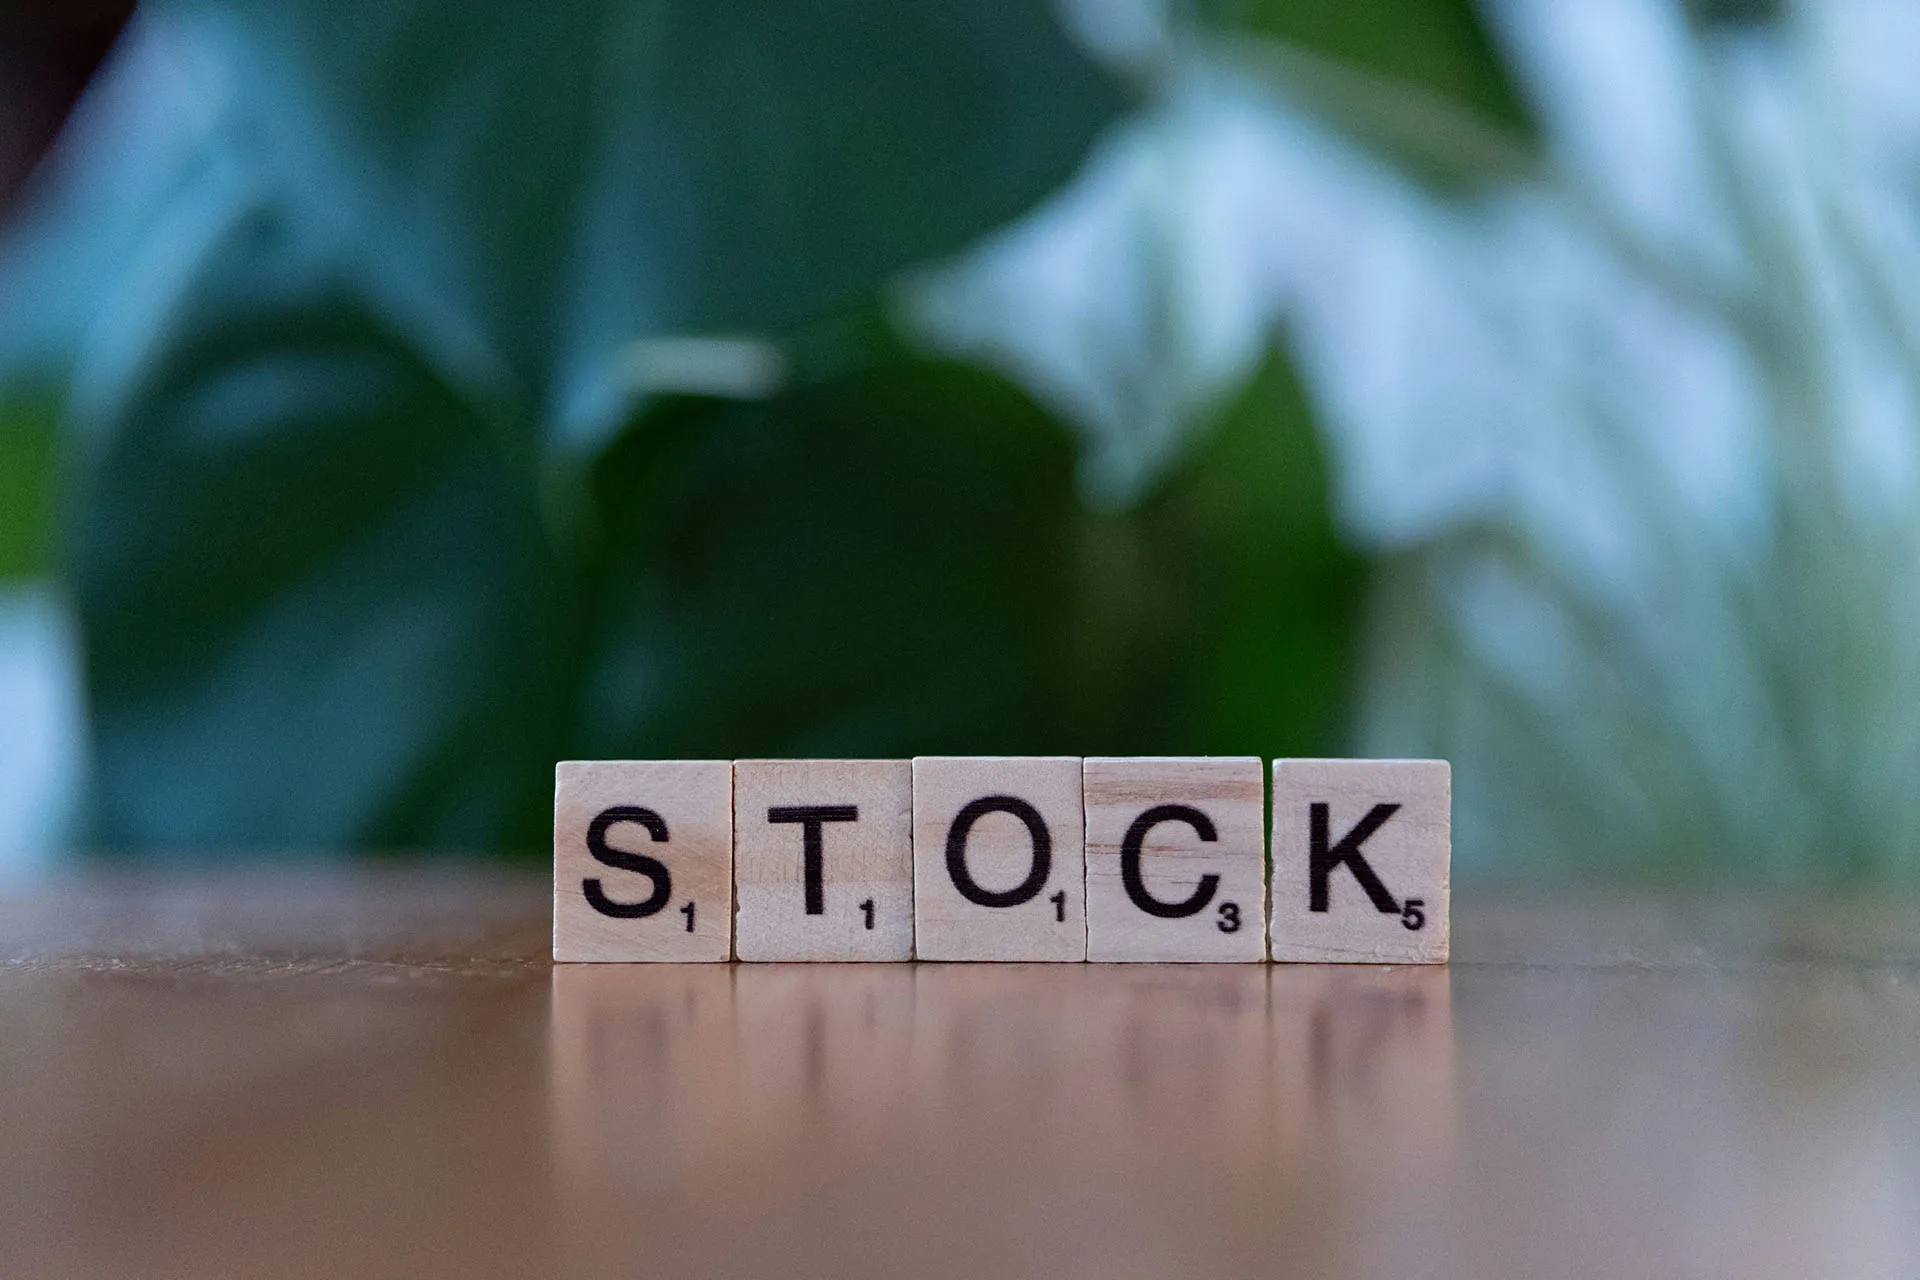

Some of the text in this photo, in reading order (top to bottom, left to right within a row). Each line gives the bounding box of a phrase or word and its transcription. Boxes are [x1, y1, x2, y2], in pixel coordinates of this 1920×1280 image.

[680, 901, 696, 933] 1
[859, 899, 875, 930] 1
[1049, 890, 1066, 923] 1
[1216, 902, 1242, 934] 3
[1400, 899, 1426, 931] 5
